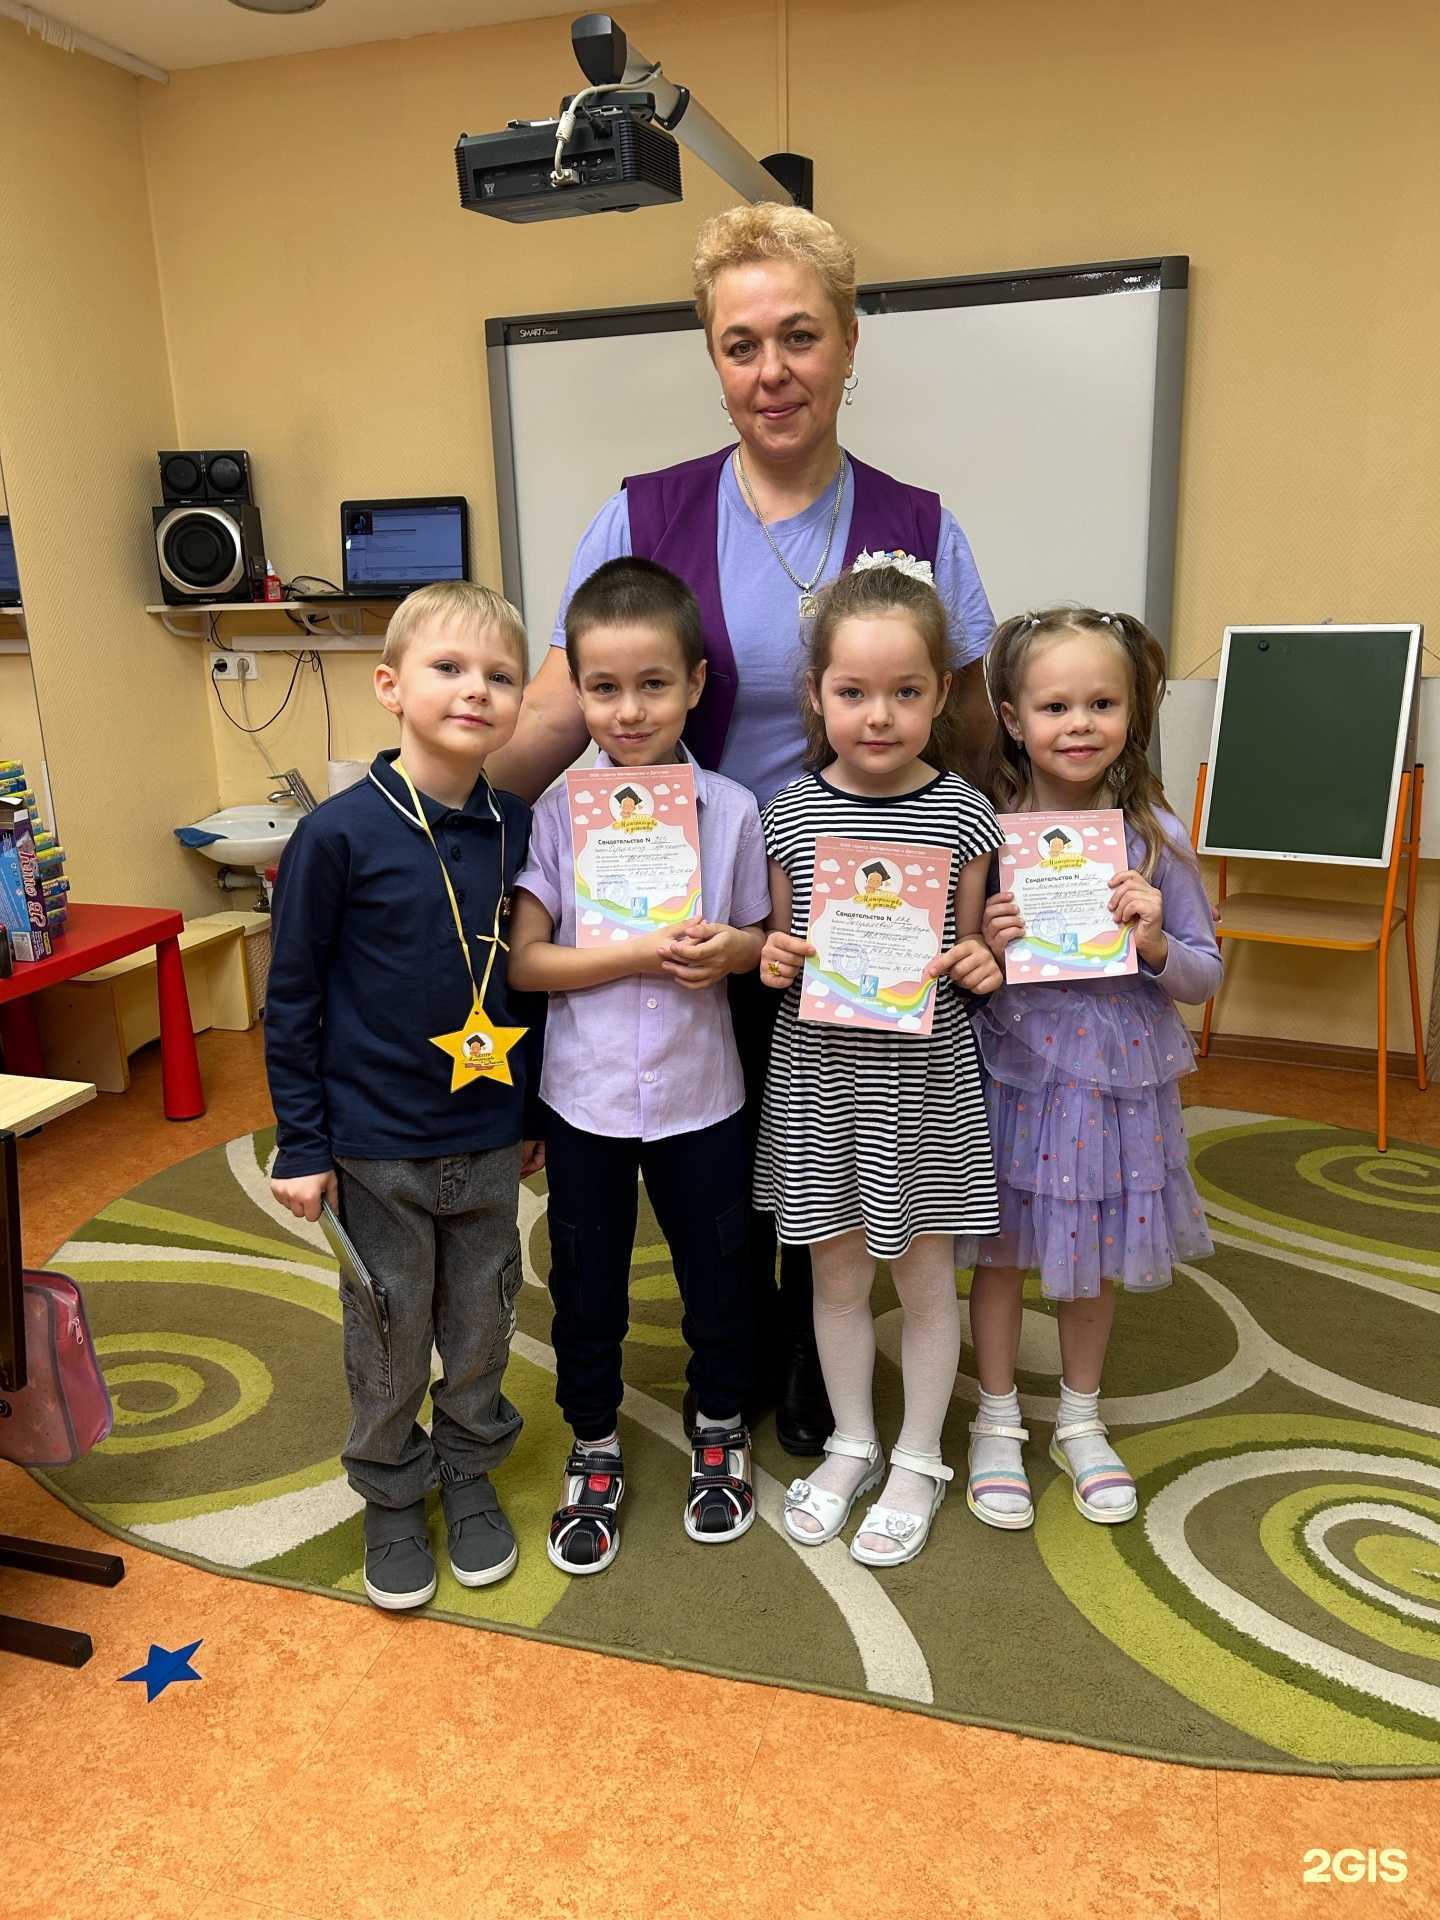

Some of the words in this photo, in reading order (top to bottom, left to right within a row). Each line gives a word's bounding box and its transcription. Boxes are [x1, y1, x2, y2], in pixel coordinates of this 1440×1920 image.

[519, 328, 542, 338] SMART
[597, 837, 644, 846] Свидетельство
[1025, 874, 1073, 885] Свидетельство
[835, 910, 885, 921] Свидетельство
